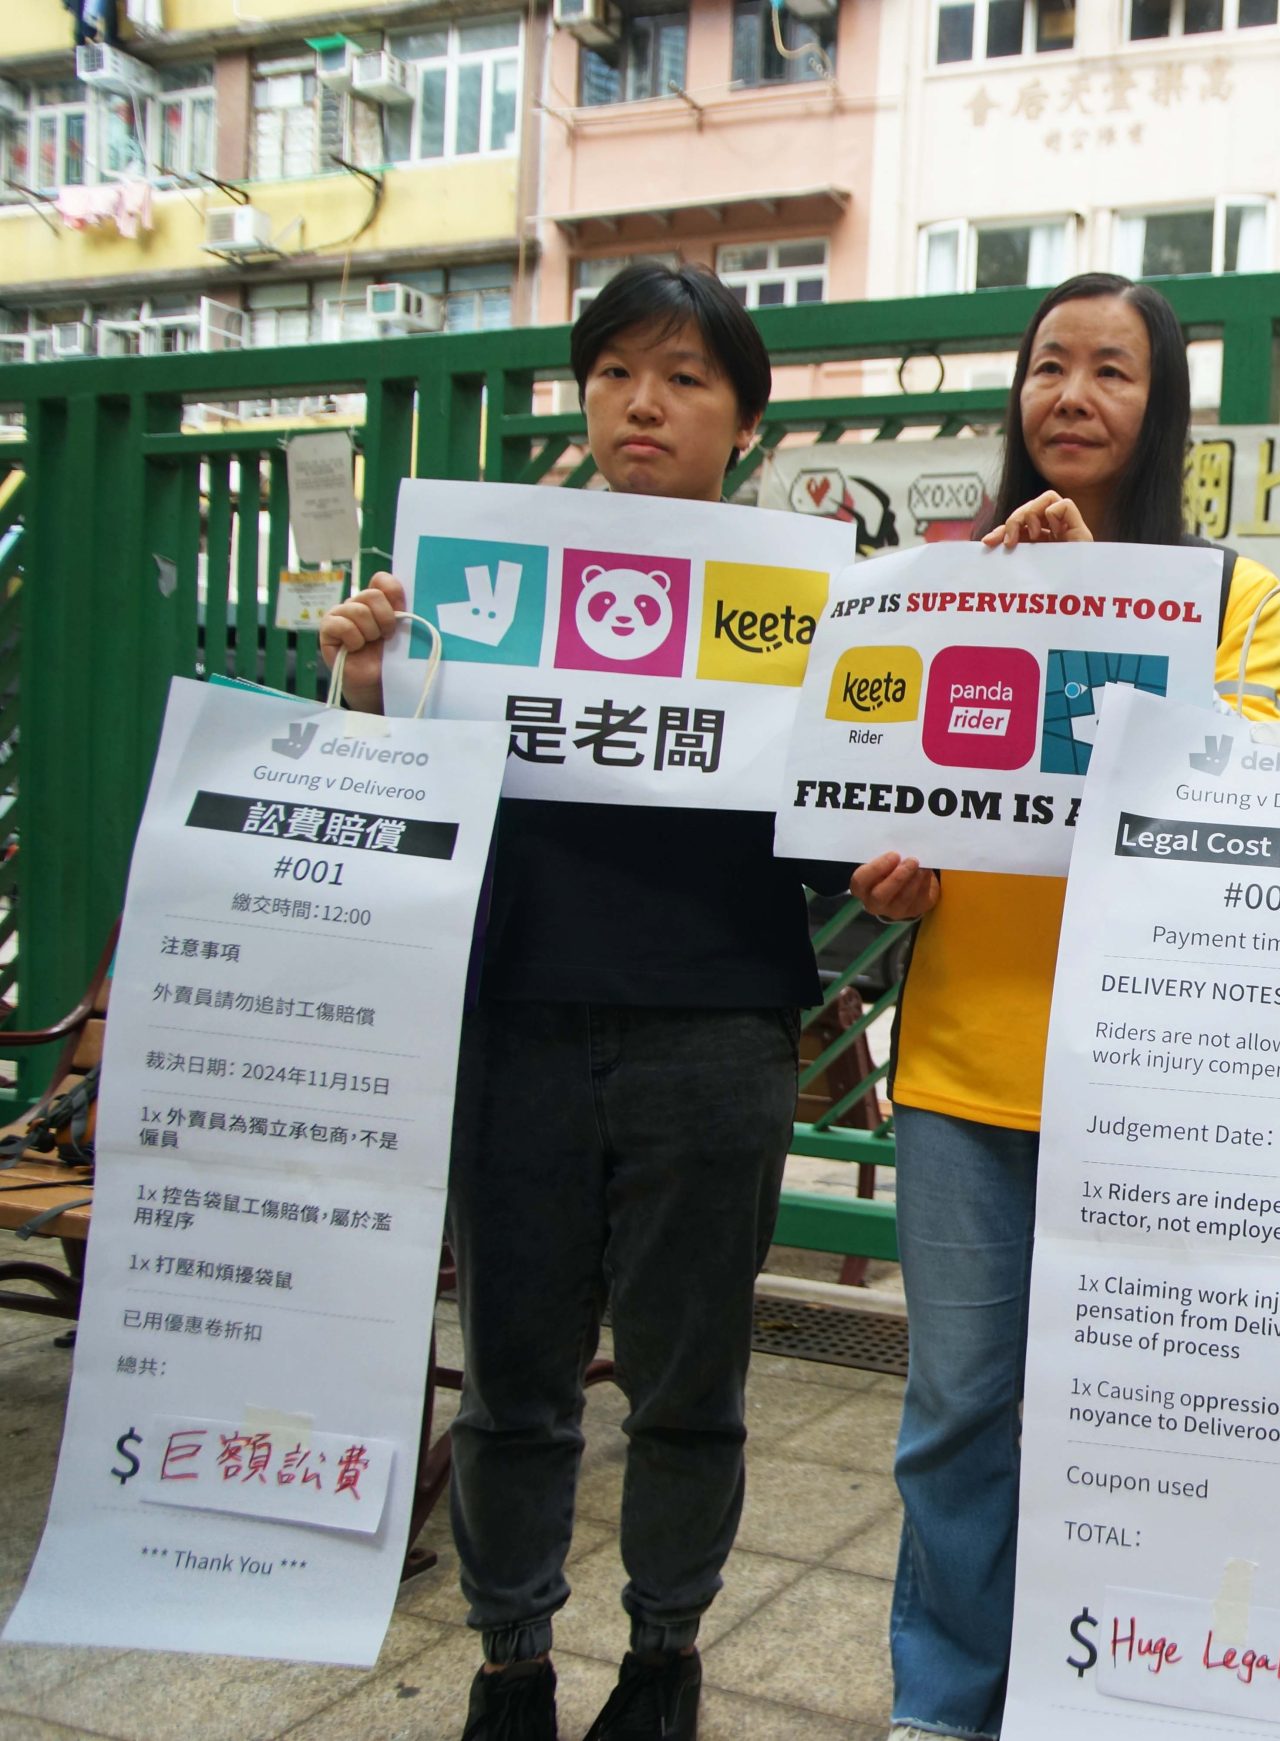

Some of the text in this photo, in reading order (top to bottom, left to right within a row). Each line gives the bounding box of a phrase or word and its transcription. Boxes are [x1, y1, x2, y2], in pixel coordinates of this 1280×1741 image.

[912, 482, 978, 508] XOXO
[830, 592, 1202, 623] APP IS SUPERVISION TOOL
[715, 600, 816, 653] keeta
[843, 671, 905, 712] keeta
[950, 681, 1013, 704] panda
[505, 695, 725, 773] 是老闆
[953, 711, 1004, 731] rider
[320, 737, 429, 767] deliveroo
[849, 729, 883, 745] Rider
[253, 765, 426, 802] Gurung v Deliveroo
[1176, 784, 1251, 810] Gurung
[1256, 795, 1268, 807] v
[794, 780, 1001, 819] FREEDOM
[1013, 793, 1054, 825] IS
[242, 801, 407, 852] 訟費賠償
[1121, 823, 1198, 855] Legal
[1207, 832, 1272, 857] Cost
[273, 856, 344, 886] #001
[160, 935, 241, 963] 注意事項
[1152, 925, 1246, 950] Payment
[1101, 974, 1207, 999] DELIVERY
[152, 983, 376, 1027] 外賣員請勿追討工傷賠償
[1096, 1022, 1156, 1043] Riders
[1162, 1029, 1193, 1045] are
[1198, 1031, 1231, 1048] not
[1092, 1048, 1141, 1067] work
[1147, 1050, 1204, 1075] injury
[140, 1107, 162, 1124] 1x
[1086, 1115, 1209, 1143] Judgement
[136, 1184, 158, 1201] 1x
[1082, 1181, 1103, 1199] 1x
[1108, 1183, 1171, 1205] Riders
[1176, 1190, 1208, 1208] are
[133, 1207, 195, 1231] 用程序
[1080, 1207, 1152, 1232] tractor,
[1157, 1214, 1190, 1232] not
[129, 1254, 293, 1290] 1x 打壓和煩擾袋鼠
[1078, 1274, 1099, 1292] 1x
[1104, 1276, 1193, 1306] Claiming
[1198, 1287, 1248, 1307] work
[1075, 1301, 1175, 1327] pensation
[1180, 1311, 1228, 1332] from
[1074, 1326, 1240, 1360] abuse of process
[1070, 1378, 1092, 1397] 1x
[1097, 1380, 1175, 1409] Causing
[1069, 1406, 1280, 1443] noyance to Deliveroo
[110, 1427, 370, 1500] $ 巨額訟費
[1066, 1465, 1209, 1499] Coupon used
[174, 1550, 273, 1575] Thank You
[1066, 1606, 1099, 1678] $
[1111, 1616, 1183, 1675] Huge
